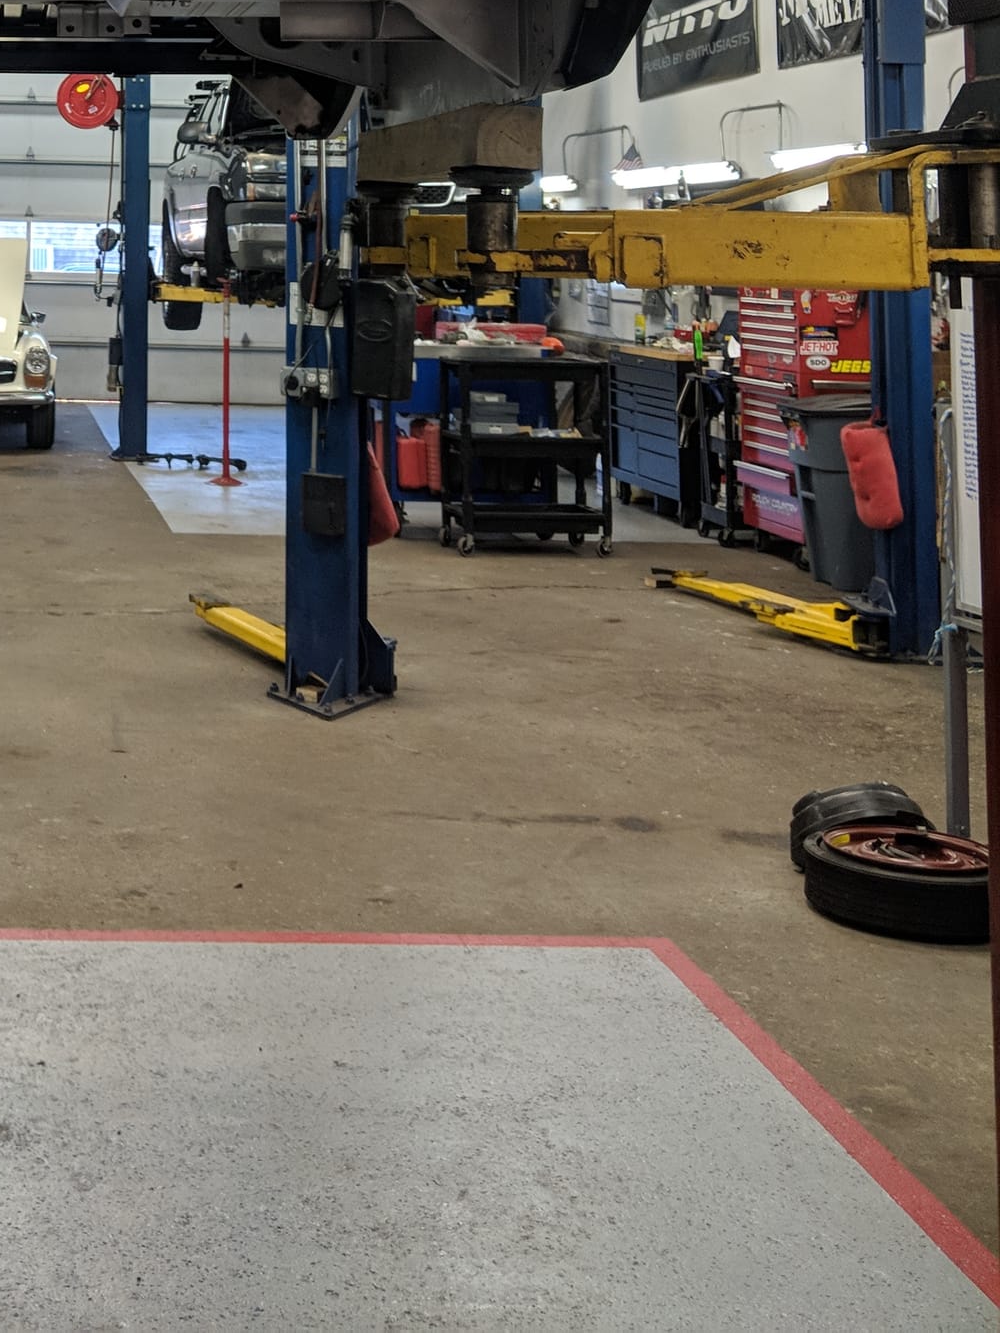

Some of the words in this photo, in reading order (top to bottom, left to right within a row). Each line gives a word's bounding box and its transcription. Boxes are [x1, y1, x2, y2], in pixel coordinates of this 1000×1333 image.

[685, 31, 751, 61] ENTHUSIASTS
[801, 342, 837, 353] JET-HOT
[831, 360, 871, 373] JEGS
